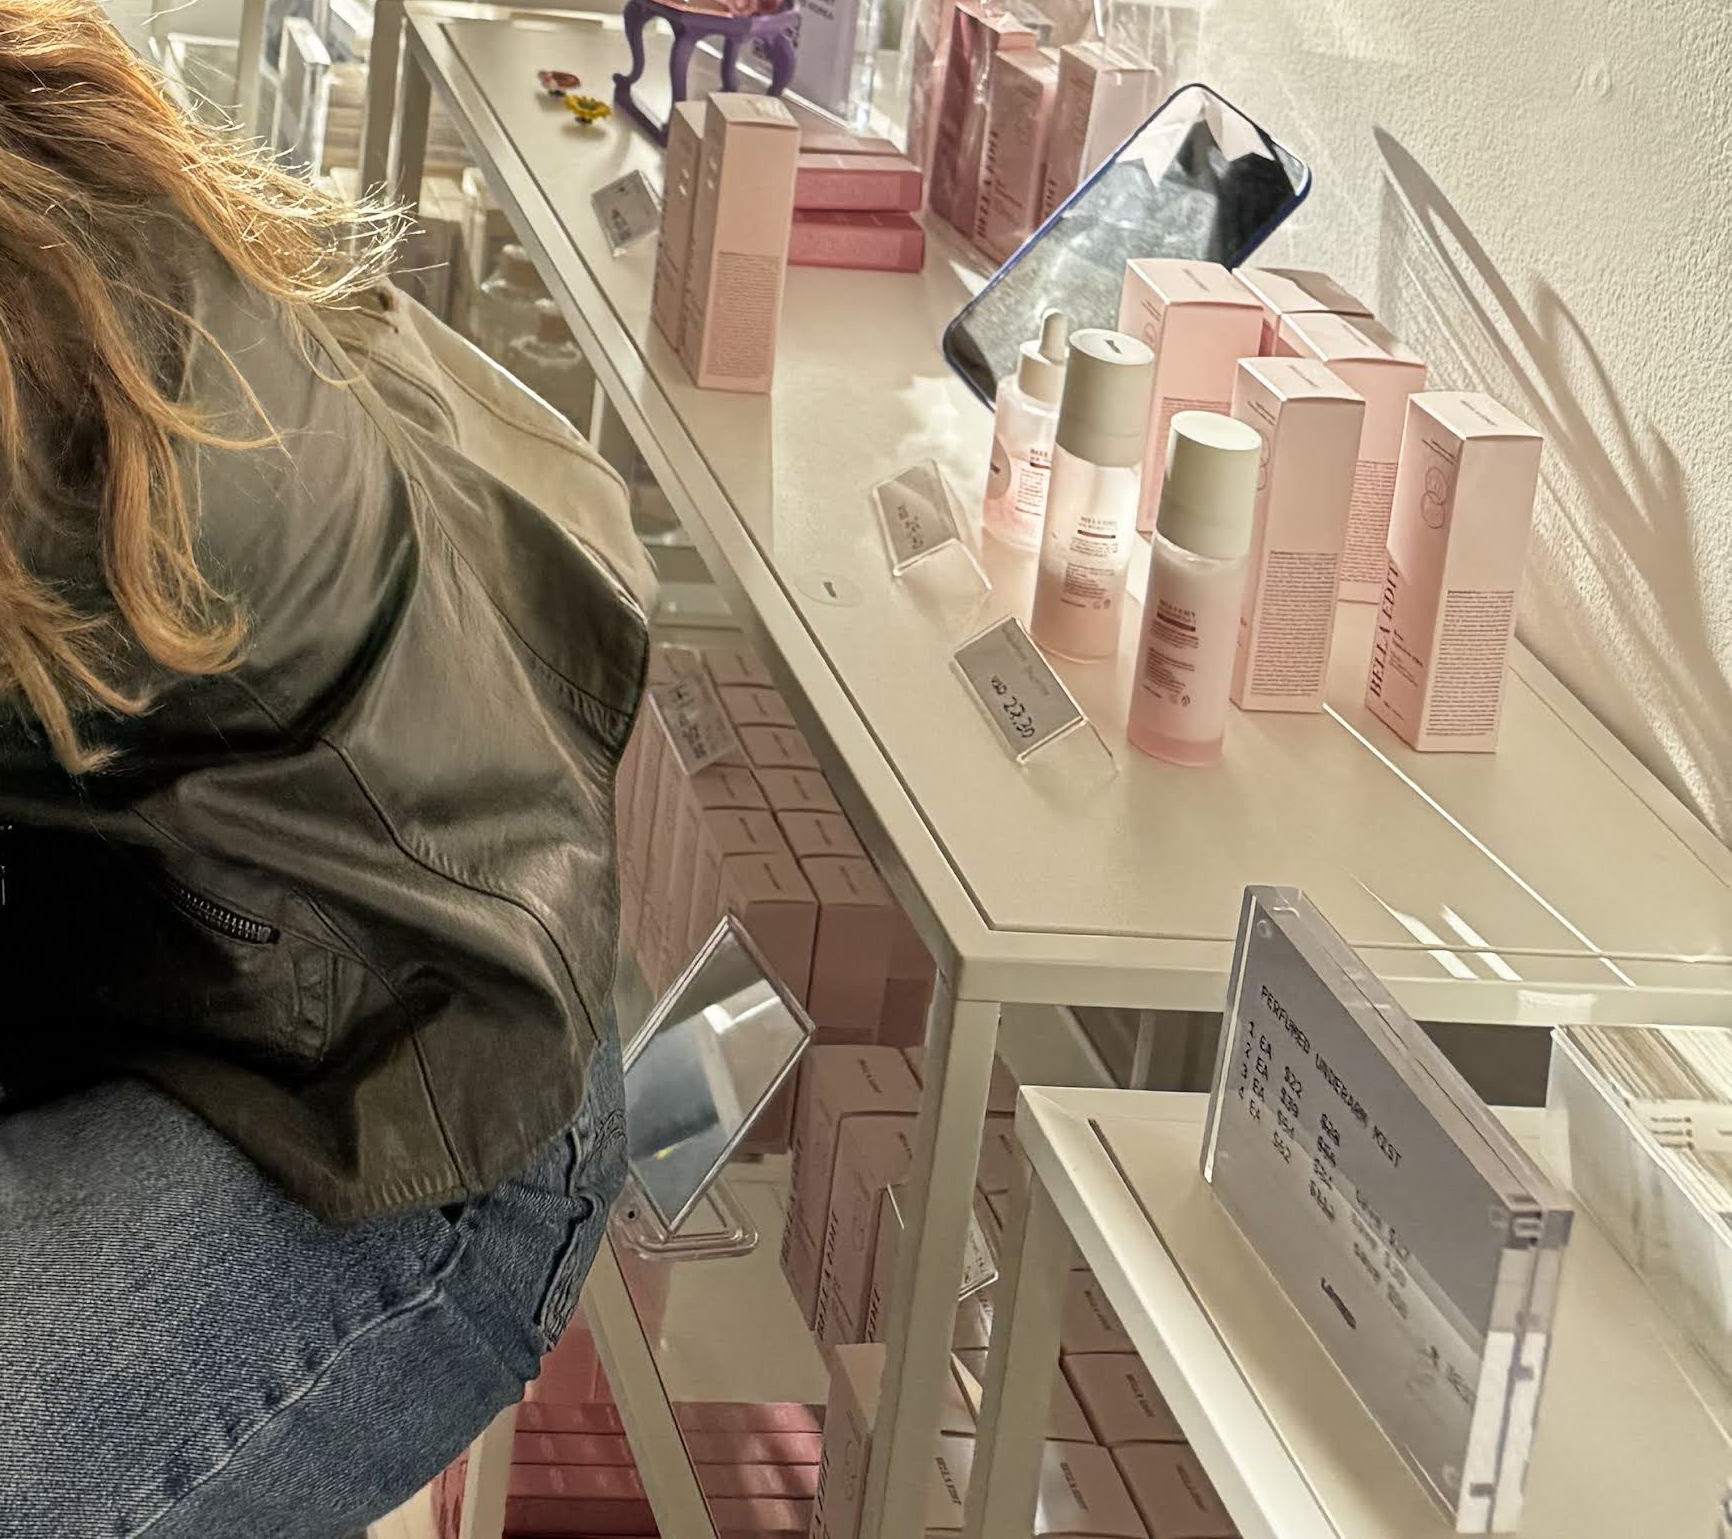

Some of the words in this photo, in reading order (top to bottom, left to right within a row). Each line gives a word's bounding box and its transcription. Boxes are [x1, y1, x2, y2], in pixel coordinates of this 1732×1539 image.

[1370, 624, 1391, 698] BELLA
[1242, 1064, 1247, 1080] 3
[1253, 1078, 1265, 1103] EA
[1245, 1043, 1250, 1058] 2
[1256, 1056, 1268, 1081] EA
[1280, 1087, 1298, 1119] $39
[1260, 1034, 1272, 1059] EA
[1284, 1065, 1302, 1098] $22
[1261, 984, 1310, 1055] PERFUMED
[1372, 1125, 1401, 1171] MIST
[1249, 1099, 1261, 1124] EA
